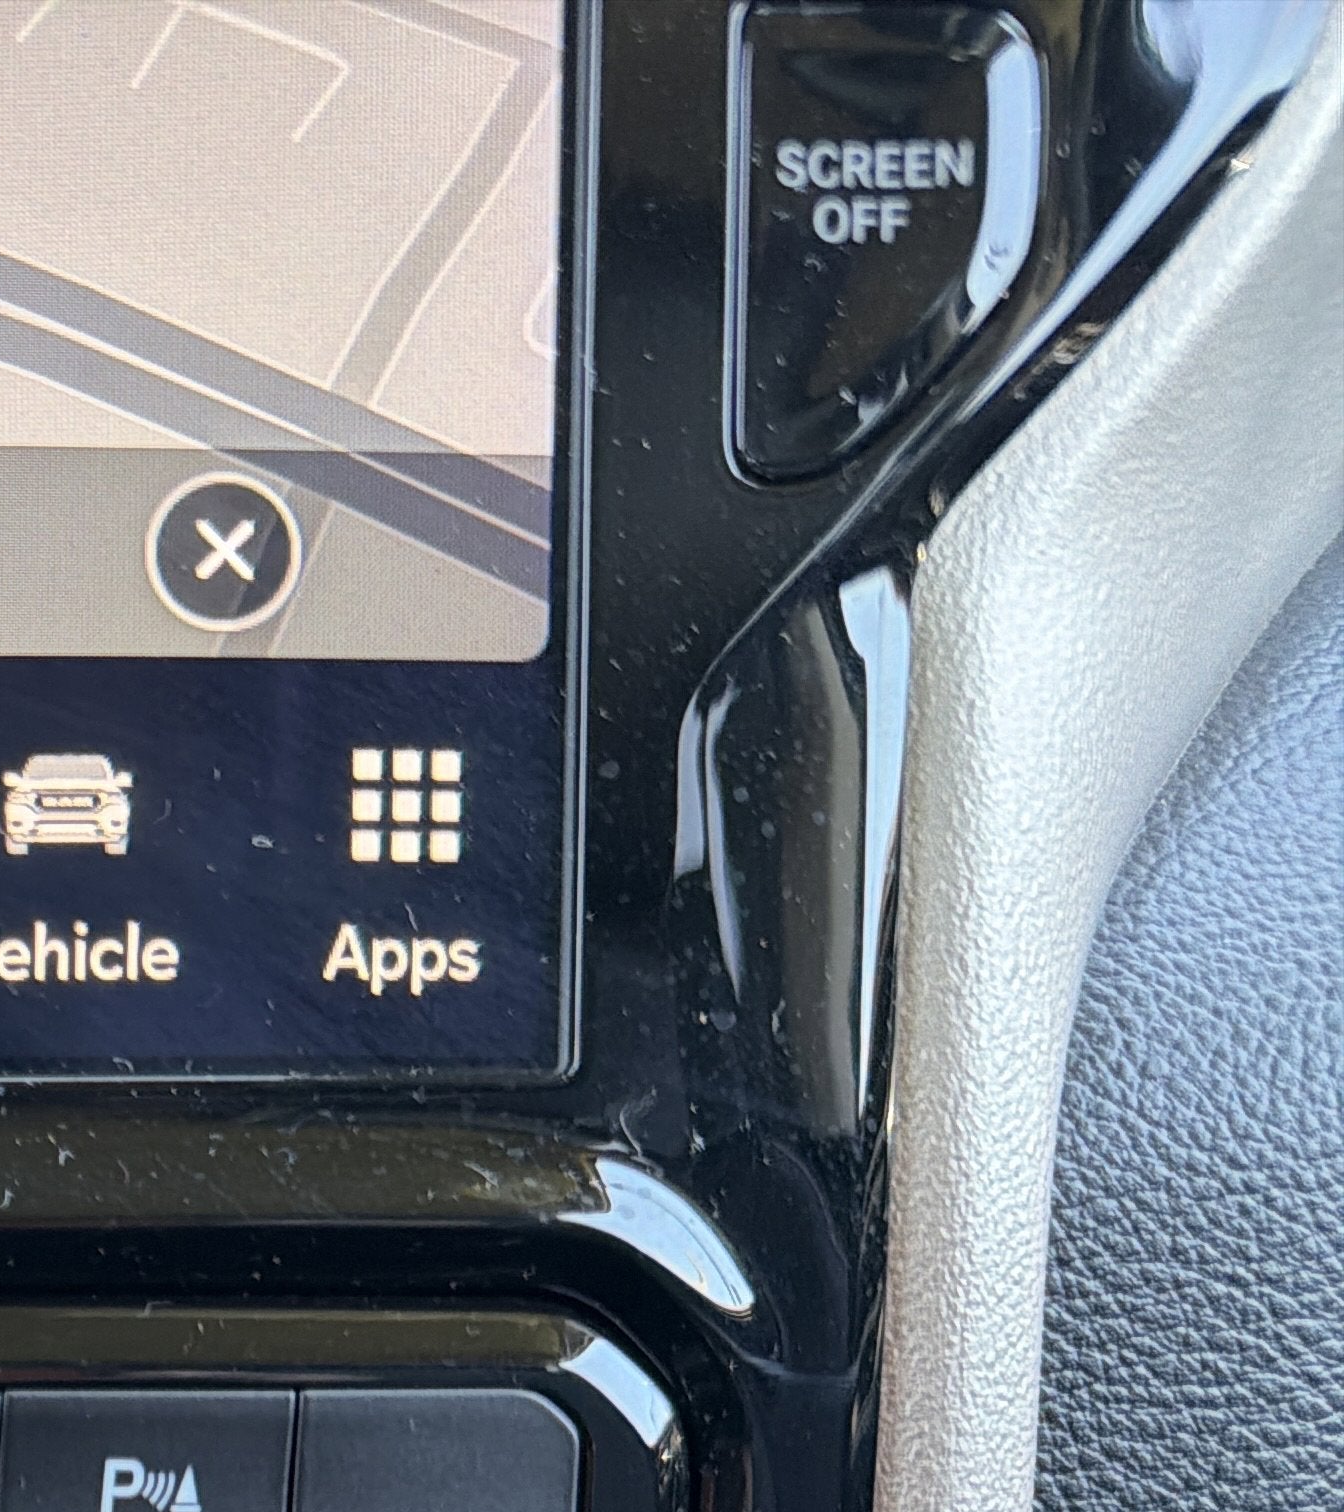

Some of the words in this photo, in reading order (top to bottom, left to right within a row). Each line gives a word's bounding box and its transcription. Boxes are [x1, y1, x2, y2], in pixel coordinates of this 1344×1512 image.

[776, 140, 975, 190] SCREEN
[812, 199, 910, 244] OFF
[322, 922, 481, 997] Apps
